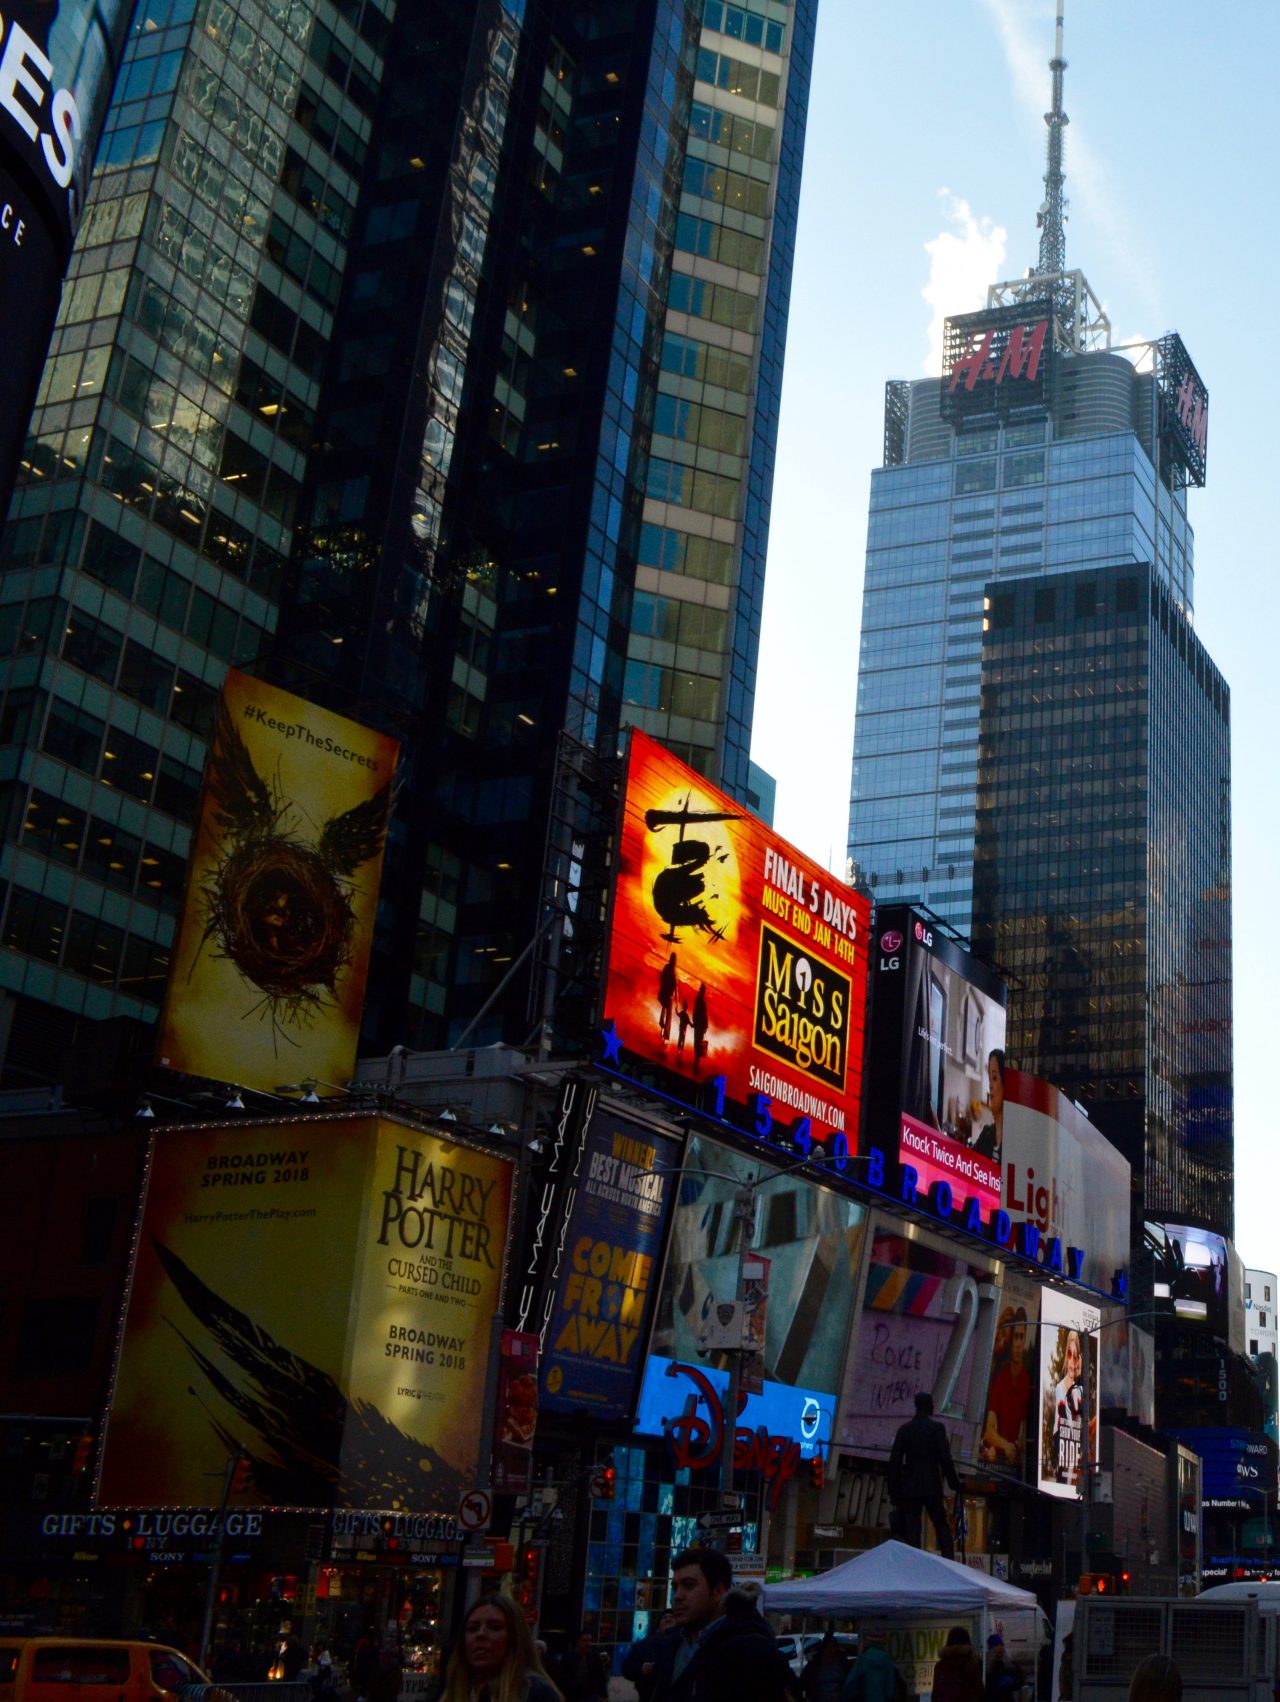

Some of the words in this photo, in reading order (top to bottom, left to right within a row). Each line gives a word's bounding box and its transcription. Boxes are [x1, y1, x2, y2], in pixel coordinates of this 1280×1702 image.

[0, 10, 82, 188] ES
[949, 321, 1048, 392] H&M
[243, 704, 379, 772] #KeepTheSecrets
[764, 847, 805, 905] FINAL
[809, 880, 820, 913] 5
[823, 889, 857, 940] DAYS
[762, 885, 791, 921] MUST
[792, 905, 811, 935] END
[813, 920, 831, 950] JAN
[834, 933, 855, 965] 14TH
[880, 957, 900, 971] LG
[761, 988, 841, 1076] Saigon
[749, 1064, 845, 1132] SAIGONBROADWAY.COM
[207, 1150, 310, 1170] BROADWAY
[903, 1125, 930, 1155] Knock
[931, 1140, 954, 1168] Twice
[955, 1154, 972, 1177] And
[973, 1162, 988, 1185] See
[201, 1170, 266, 1188] SPRING
[272, 1168, 310, 1184] 2018
[392, 1144, 497, 1221] HARRY
[589, 1151, 620, 1186] BEST
[618, 1161, 665, 1204] MUSICAL
[184, 1208, 317, 1225] HarryPotterThePlay.com
[377, 1190, 497, 1270] POTTER
[868, 1145, 1085, 1281] BROADWAY
[388, 1258, 439, 1285] CURSED
[441, 1272, 482, 1296] CHILD
[419, 1254, 437, 1267] AND
[437, 1258, 453, 1271] THE
[572, 1236, 654, 1291] COME
[399, 1284, 418, 1296] PARTS
[419, 1290, 433, 1300] ONE
[434, 1294, 450, 1304] AND
[450, 1296, 466, 1308] TWO
[385, 1342, 434, 1365] SPRING
[439, 1353, 466, 1370] 2018
[389, 1324, 466, 1353] BROADWAY
[554, 1314, 640, 1364] AWAY
[397, 1387, 418, 1398] LYRIC
[1218, 1359, 1227, 1401] 1500
[41, 1514, 117, 1537] GIFTS
[136, 1513, 264, 1537] LUGGAGE
[332, 1513, 382, 1536] GIFTS
[149, 1551, 187, 1562] SONY
[411, 1553, 438, 1564] SONY
